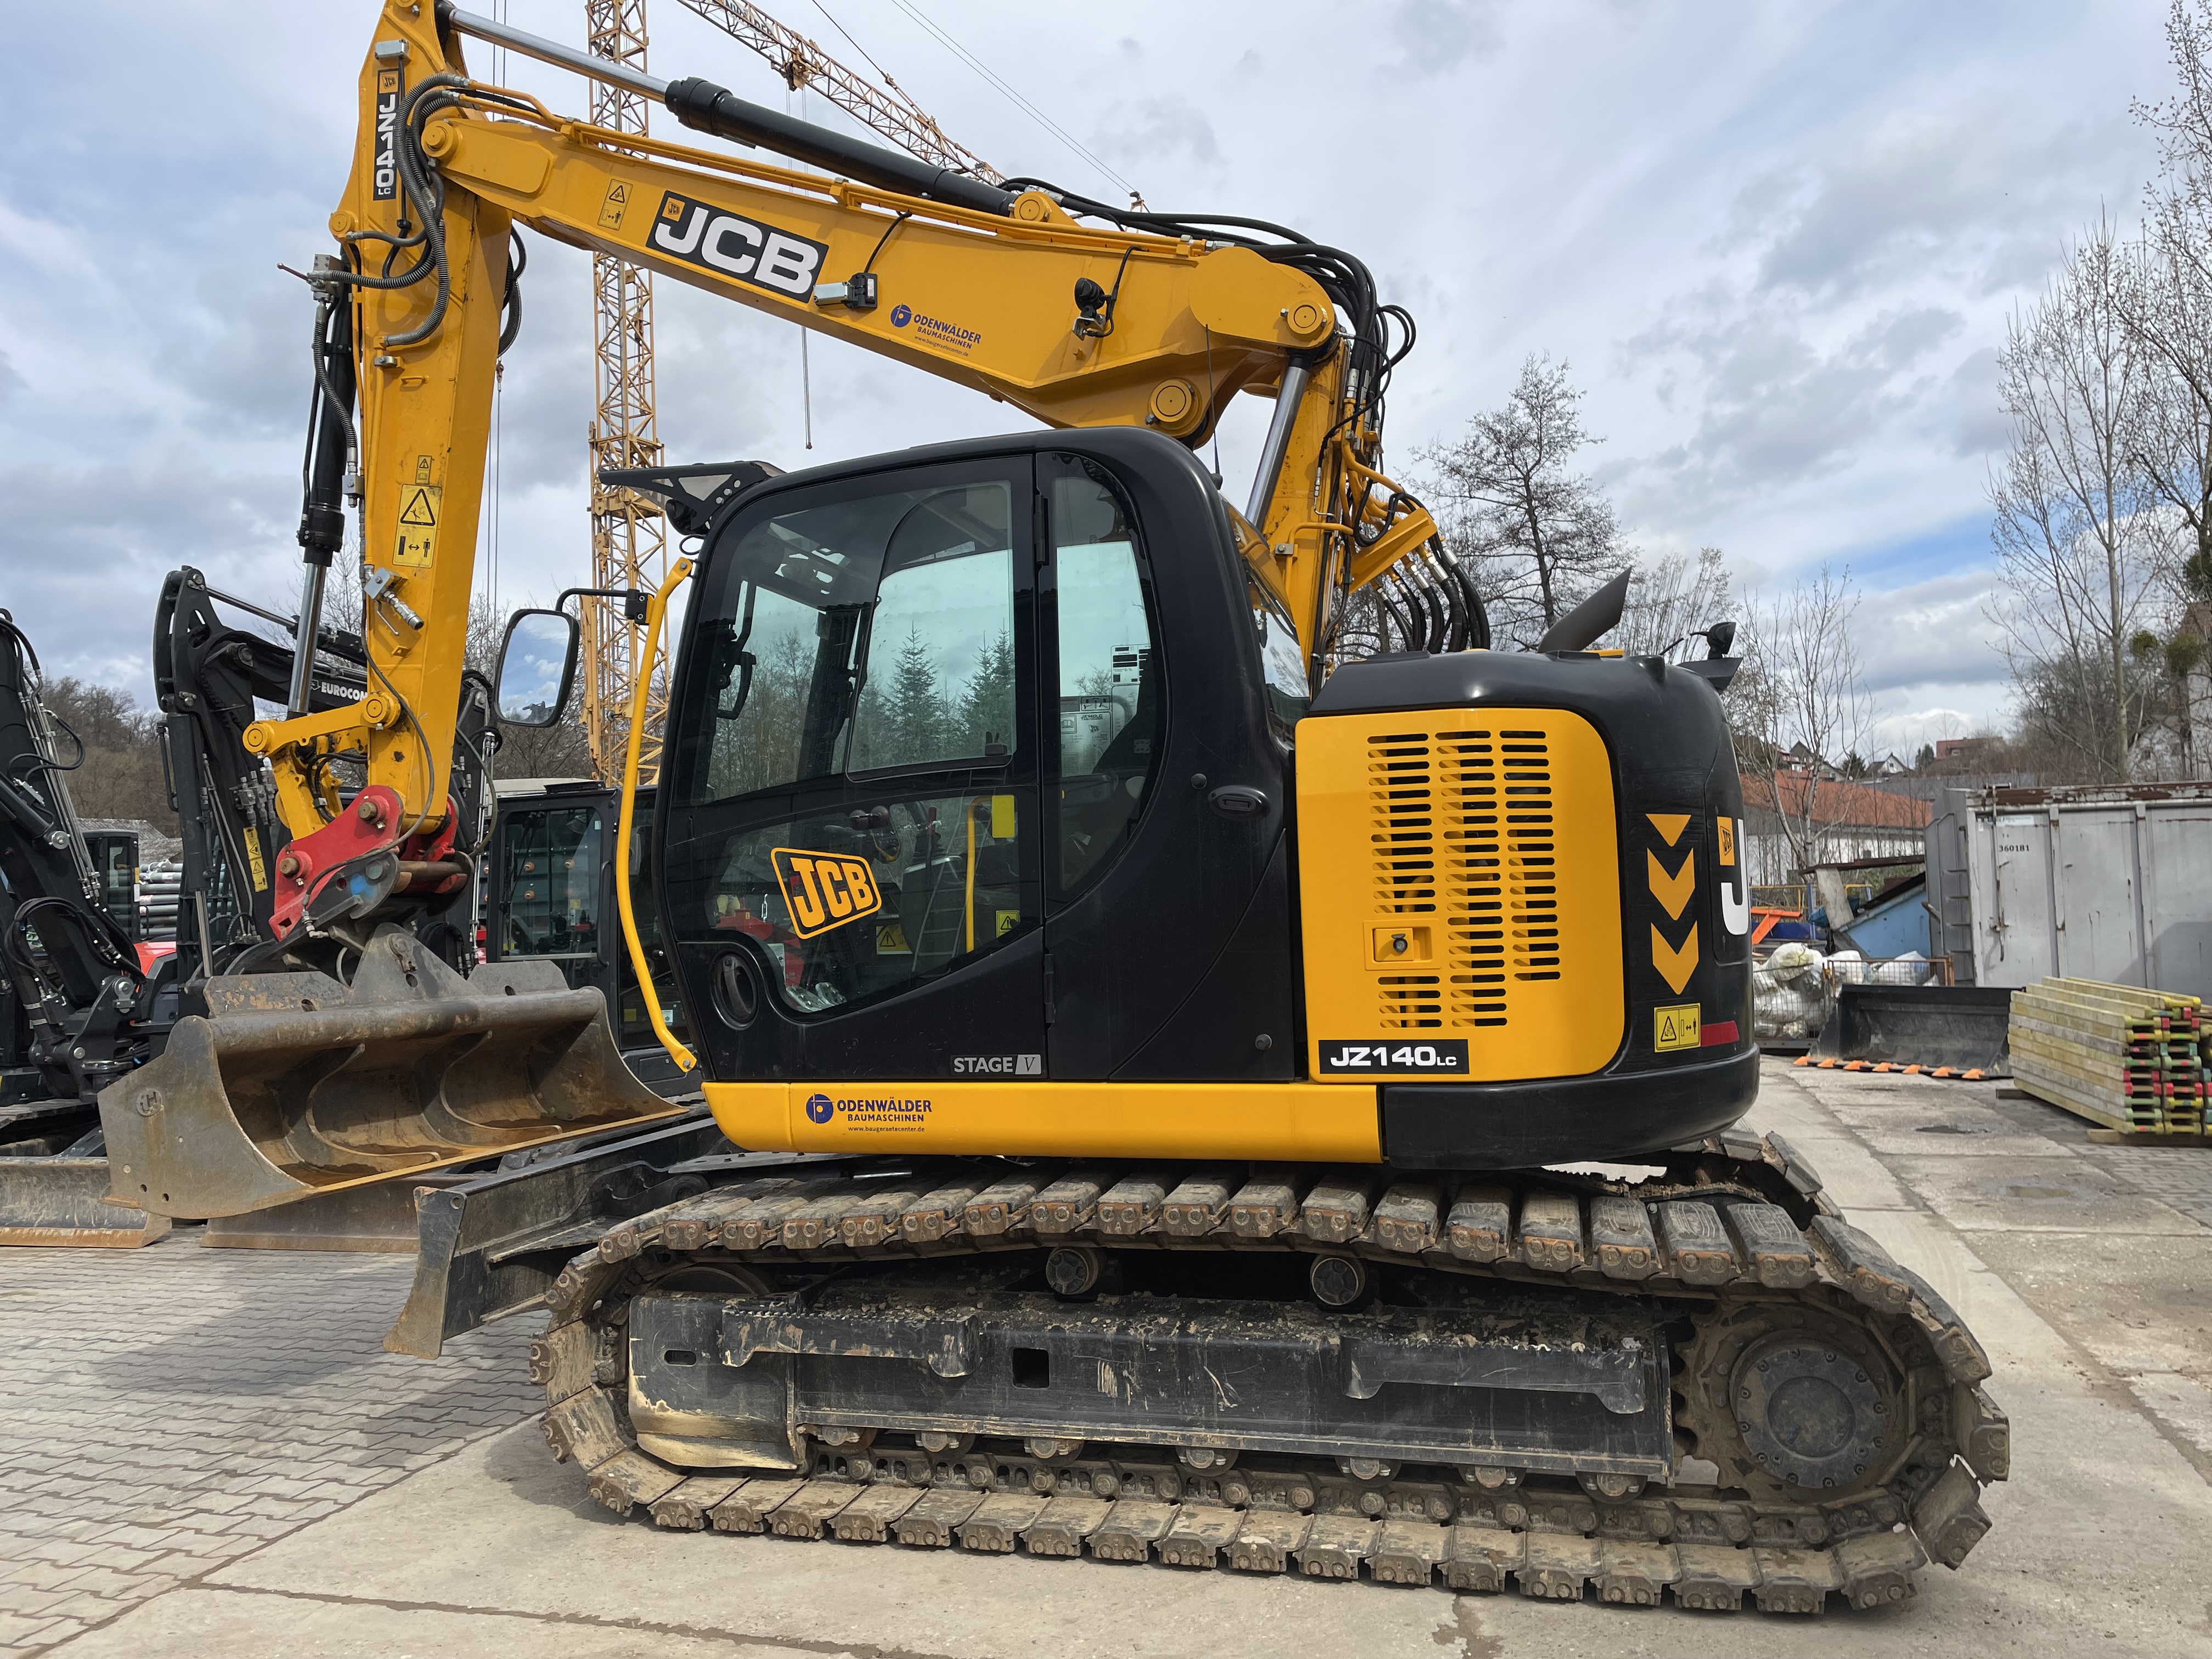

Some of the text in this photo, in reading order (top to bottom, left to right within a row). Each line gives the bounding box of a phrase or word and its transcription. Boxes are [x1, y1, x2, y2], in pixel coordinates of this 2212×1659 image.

[384, 77, 396, 87] JCB
[669, 202, 680, 215] JCB
[655, 206, 819, 294] JCB
[913, 314, 981, 344] ODENWÄLDER
[917, 326, 972, 349] BAUMASCHINEN
[914, 335, 969, 357] www.baugeraetecenter.de
[790, 857, 873, 928] JCB
[953, 1057, 1036, 1073] STAGE V
[837, 1097, 932, 1112] ODENWÄLDER
